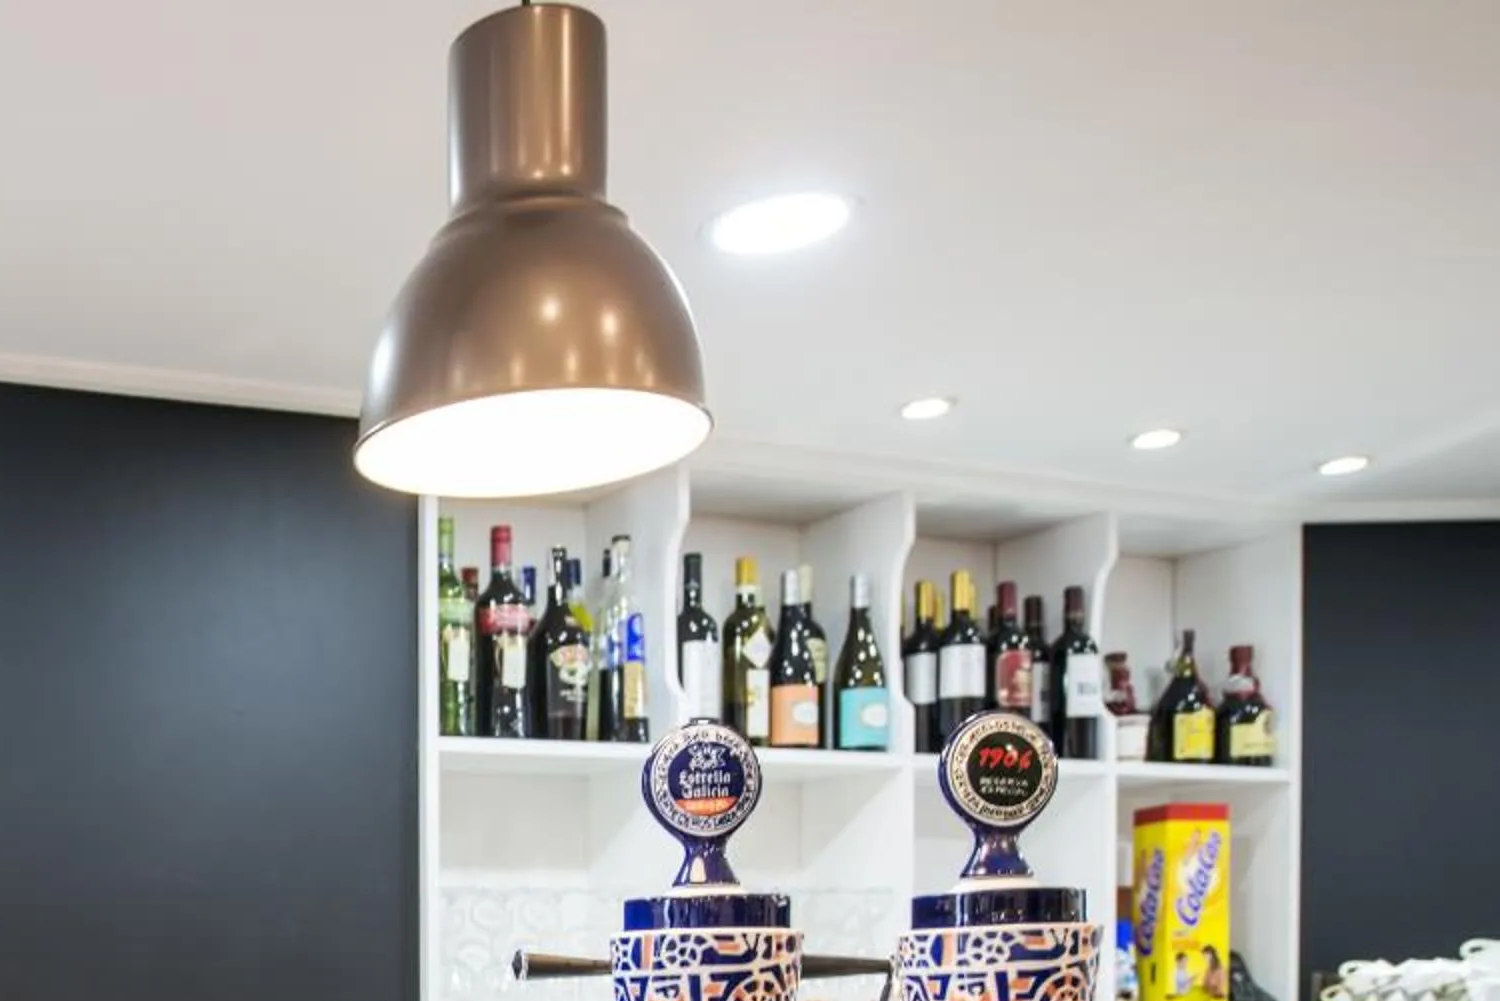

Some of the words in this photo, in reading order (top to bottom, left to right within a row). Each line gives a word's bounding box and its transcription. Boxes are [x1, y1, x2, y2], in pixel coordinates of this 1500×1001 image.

[979, 746, 1033, 769] 1906
[679, 769, 731, 785] Estrella
[681, 784, 730, 799] Galicia
